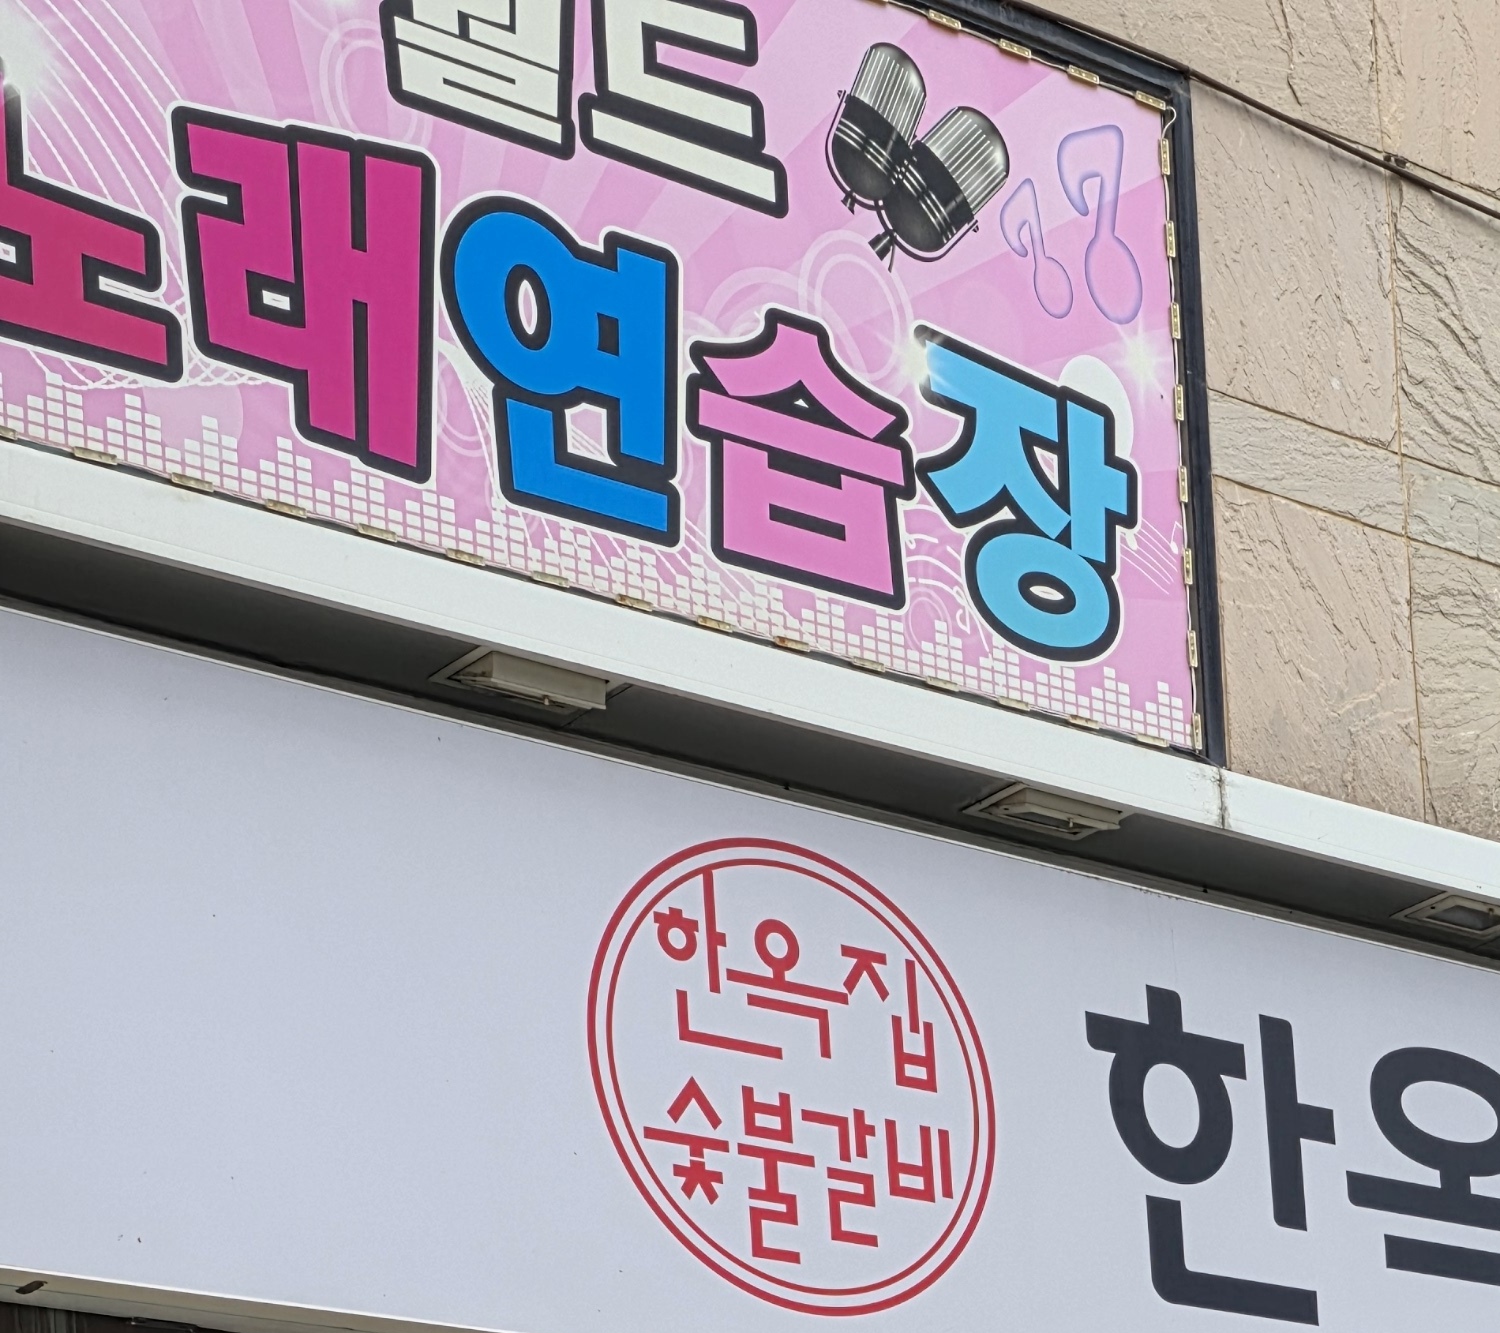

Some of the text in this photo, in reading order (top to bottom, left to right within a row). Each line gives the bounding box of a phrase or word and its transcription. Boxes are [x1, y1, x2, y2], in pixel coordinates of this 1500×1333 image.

[0, 84, 1139, 662] 노래연습장
[653, 870, 938, 1093] 한옥집
[644, 1076, 953, 1264] 숯불갈비
